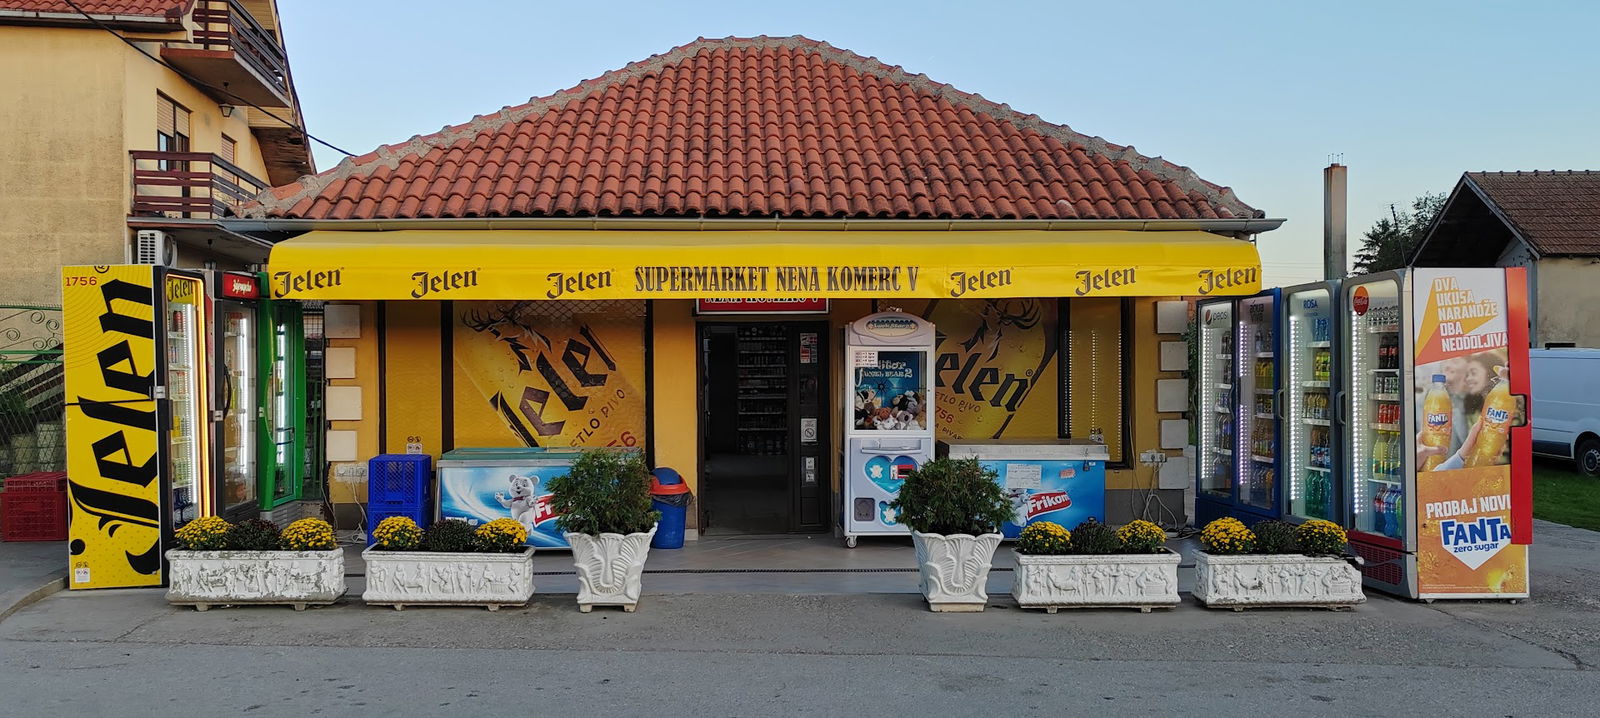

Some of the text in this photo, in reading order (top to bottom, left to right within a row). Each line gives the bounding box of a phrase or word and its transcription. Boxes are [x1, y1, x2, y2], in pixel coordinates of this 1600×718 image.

[65, 276, 97, 286] 1756
[274, 269, 341, 298] Jelen
[411, 270, 478, 299] Jelen
[546, 270, 613, 299] Jelen
[635, 266, 919, 292] SUPERMARKET NENA KOMERC V
[950, 269, 1012, 297] Jelen
[1075, 267, 1136, 296] Jelen
[1198, 266, 1256, 294] Jelen
[1434, 277, 1459, 291] DVA
[1436, 290, 1475, 306] UKUSA
[1438, 299, 1498, 320] NARANDŽE
[1440, 321, 1463, 337] OBA
[1441, 332, 1508, 353] NEODOLJIVA
[935, 332, 1029, 412] elen
[68, 278, 160, 575] Jelen
[935, 406, 955, 424] 756
[569, 418, 600, 448] ETLO
[1027, 493, 1071, 514] Frikom
[1426, 498, 1478, 519] PROBAJ
[1441, 518, 1512, 546] FANTA
[1474, 543, 1499, 552] sugar
